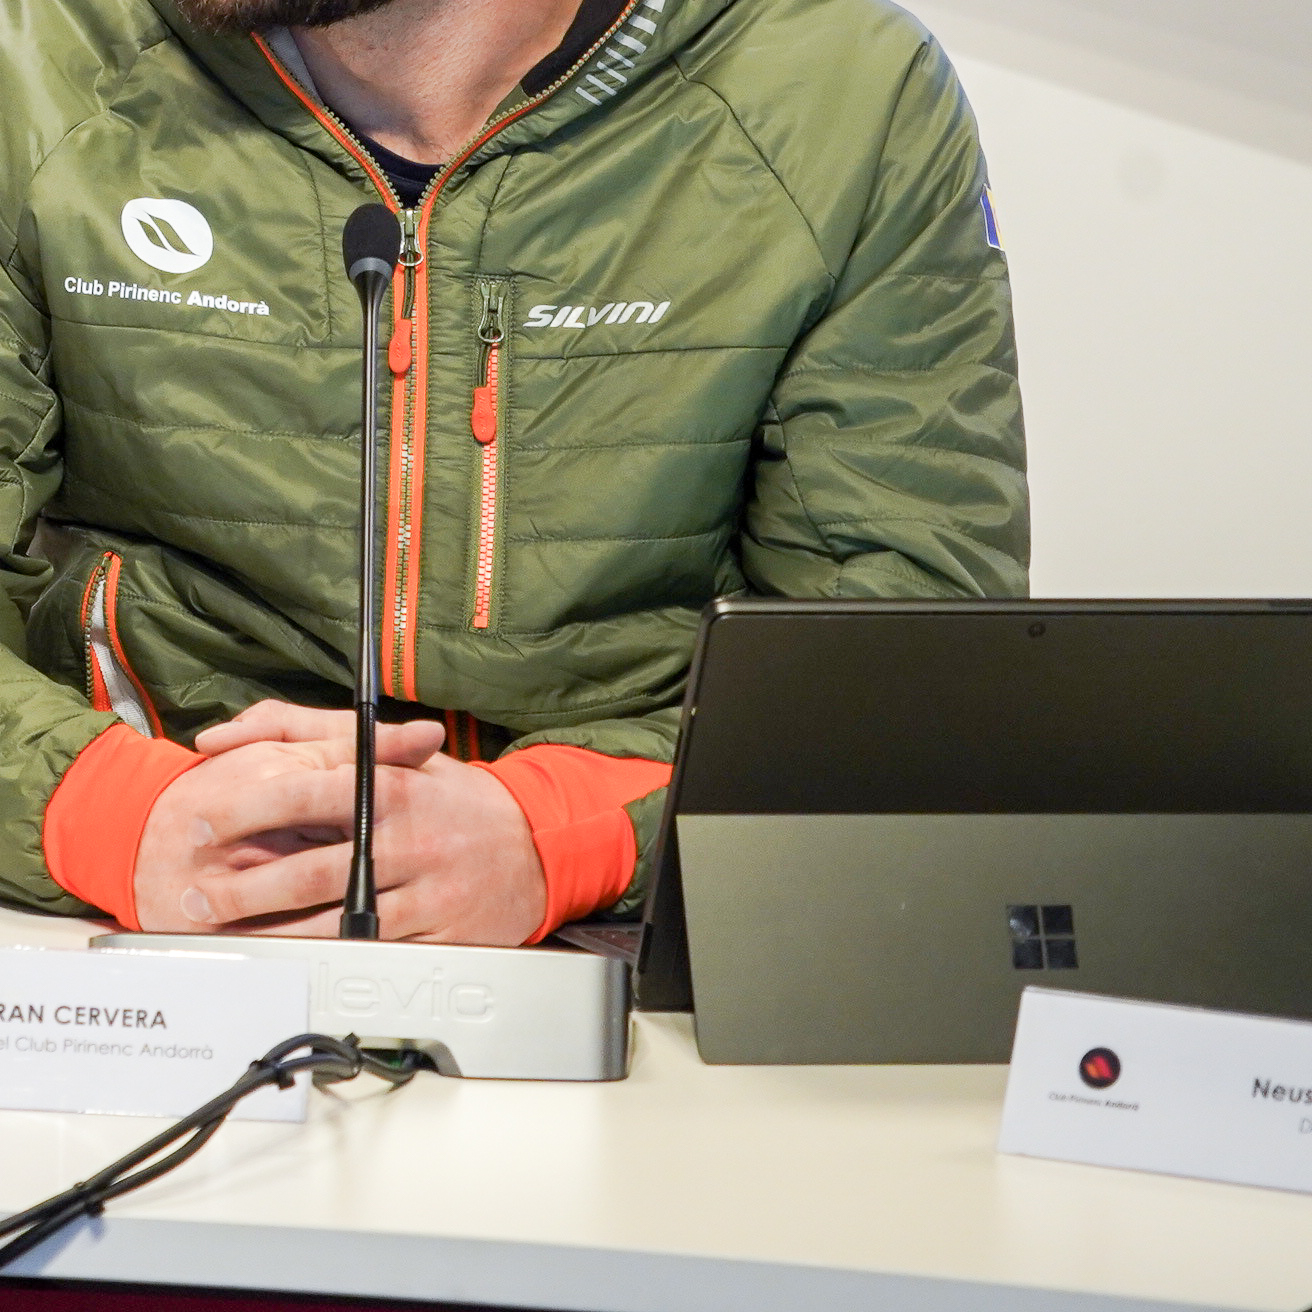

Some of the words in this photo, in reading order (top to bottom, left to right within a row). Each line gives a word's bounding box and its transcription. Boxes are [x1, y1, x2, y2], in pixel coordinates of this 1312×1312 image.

[64, 276, 104, 297] Club
[108, 281, 182, 305] Pirinenc
[187, 290, 270, 316] Andorrà
[523, 301, 671, 329] SILVINI
[54, 1005, 167, 1029] CERVERA
[15, 1036, 58, 1054] Club
[63, 1039, 133, 1056] Pirinenc
